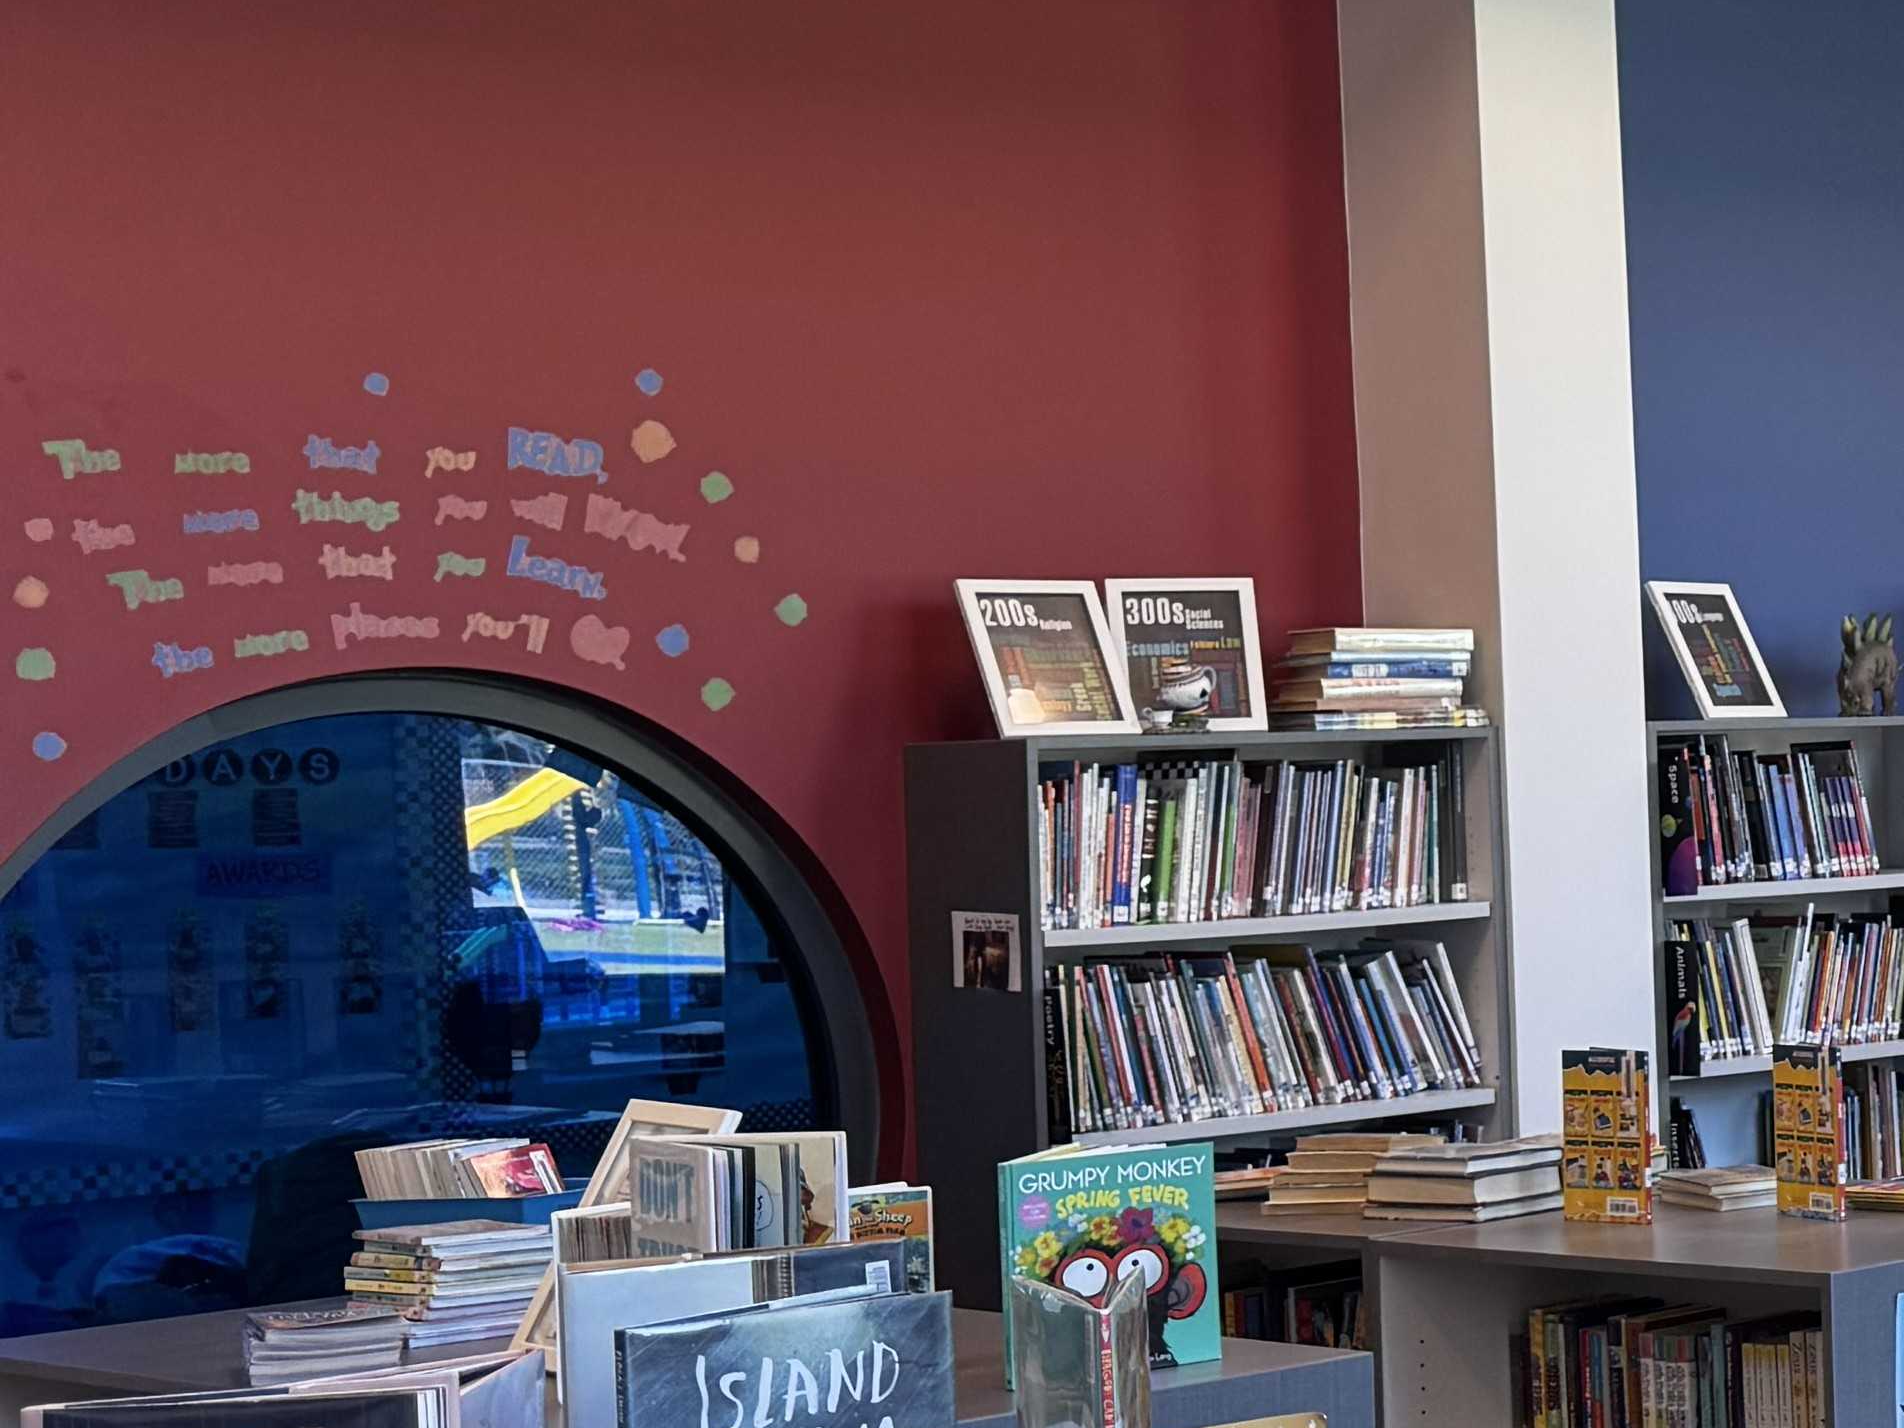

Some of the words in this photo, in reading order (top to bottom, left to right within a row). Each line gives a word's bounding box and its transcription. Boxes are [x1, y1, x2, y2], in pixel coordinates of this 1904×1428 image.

[304, 434, 381, 474] that
[426, 446, 477, 478] you
[292, 489, 400, 532] things
[979, 598, 1038, 627] 200s
[1125, 597, 1185, 626] 300s
[1668, 764, 1680, 805] Space
[1674, 946, 1687, 999] Animals
[1018, 1165, 1111, 1195] GRUMPY
[1117, 1155, 1206, 1184] MONKEY
[1055, 1190, 1121, 1220] SPRING
[1127, 1183, 1190, 1211] FEVER
